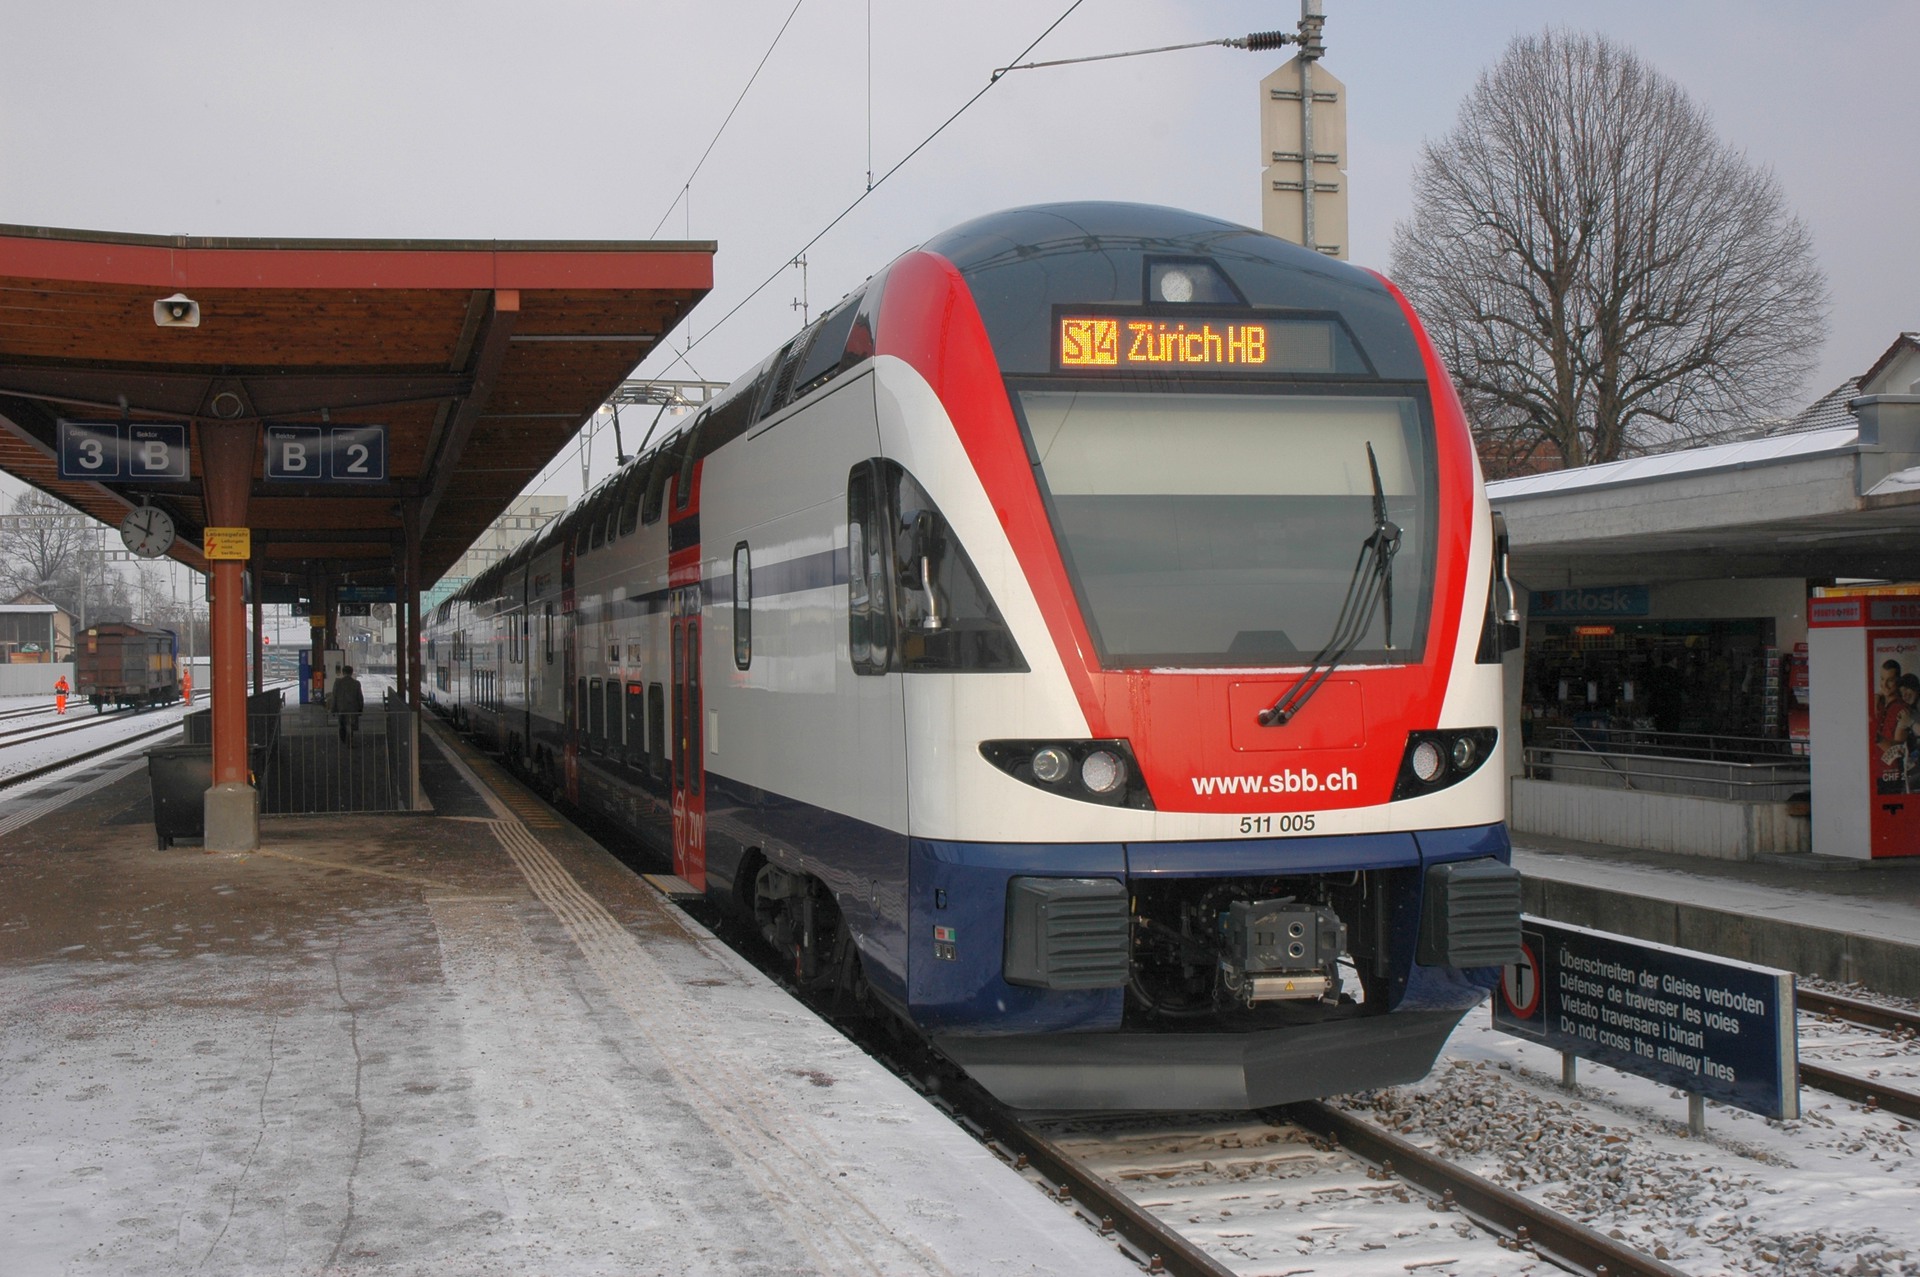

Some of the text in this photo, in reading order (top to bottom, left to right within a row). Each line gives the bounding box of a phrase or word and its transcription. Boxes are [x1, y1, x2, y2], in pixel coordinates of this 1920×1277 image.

[1063, 320, 1265, 364] S14 Zürich HB
[275, 432, 296, 440] Sektor
[79, 439, 103, 469] 3
[144, 441, 170, 470] B
[282, 442, 307, 471] B
[346, 444, 369, 473] 2
[1560, 589, 1629, 611] kiosk
[1191, 767, 1358, 796] www.sbb.ch
[1882, 772, 1900, 781] CHF
[1239, 814, 1316, 834] 511 005
[1560, 947, 1765, 1016] Überschreiten der Gleise verboten
[1560, 971, 1740, 1034] Défense de traverser les voies
[1561, 993, 1704, 1049] Vietato traversare i binari
[1561, 1015, 1735, 1082] Do not cross the railway lines
